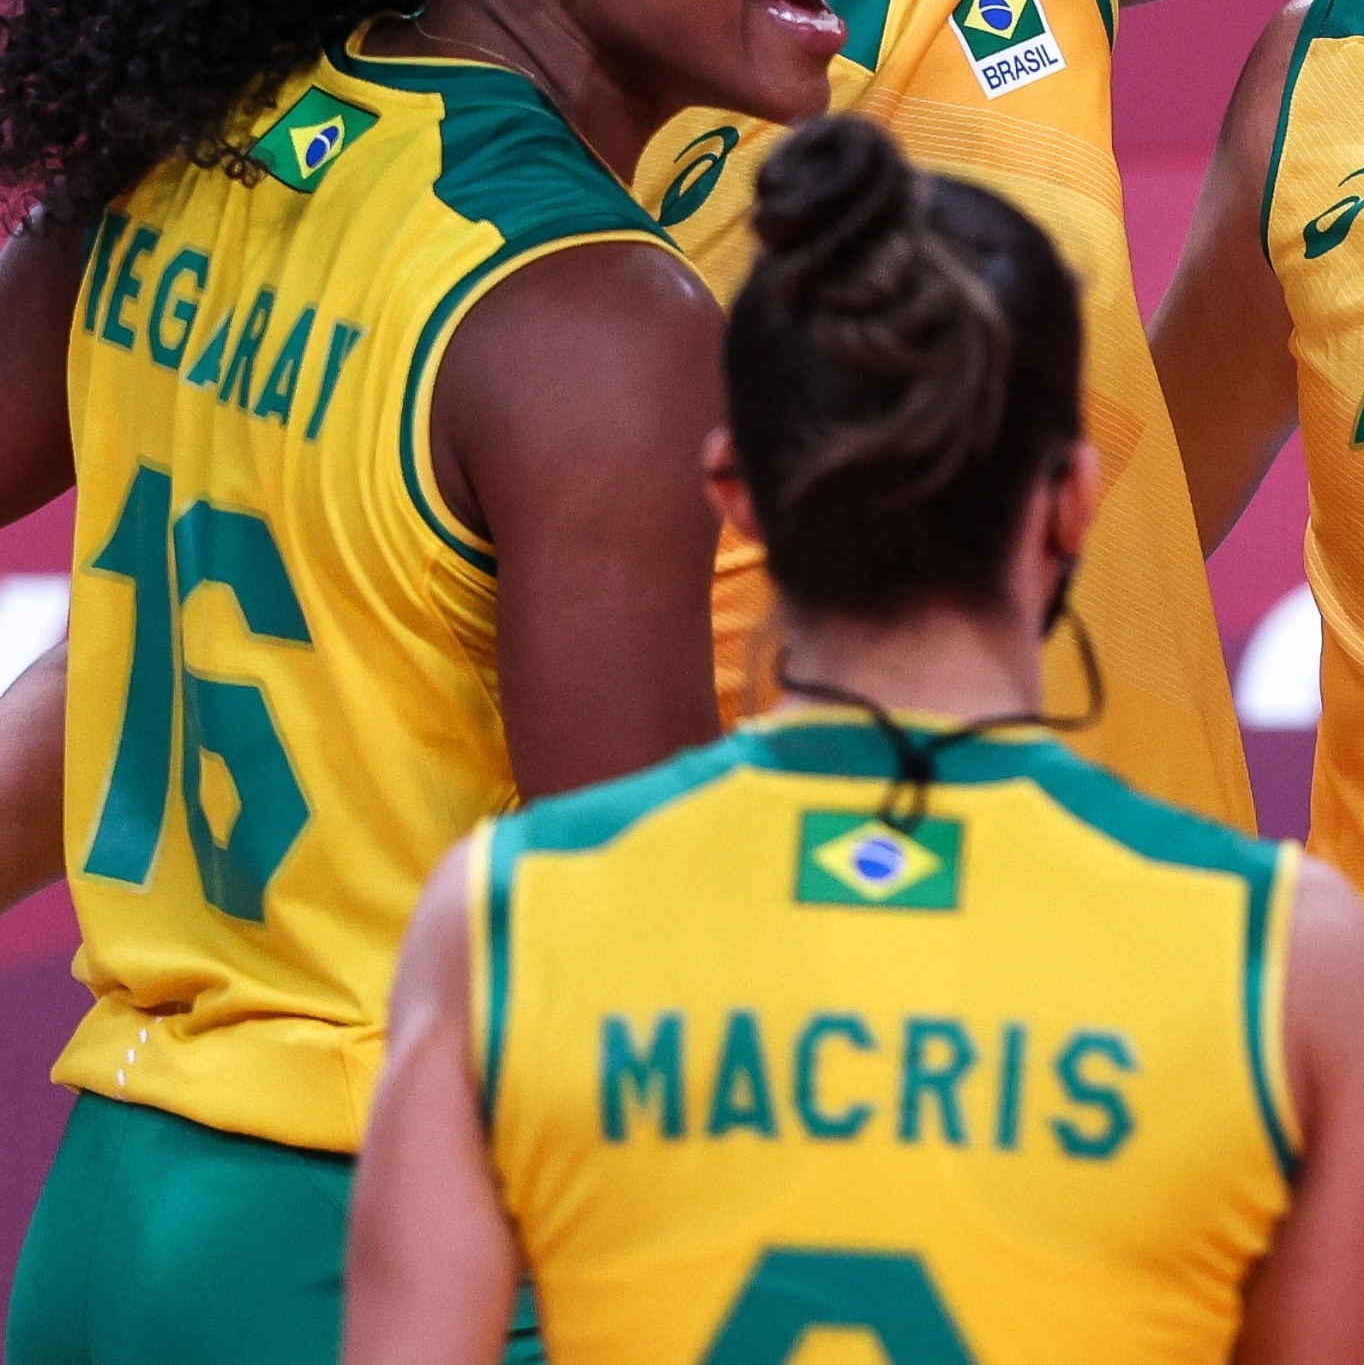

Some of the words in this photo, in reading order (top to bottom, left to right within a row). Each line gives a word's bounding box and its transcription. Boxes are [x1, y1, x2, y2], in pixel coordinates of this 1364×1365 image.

[982, 44, 1059, 90] BRASIL
[83, 464, 314, 923] 16
[598, 1009, 1139, 1164] MACRIS
